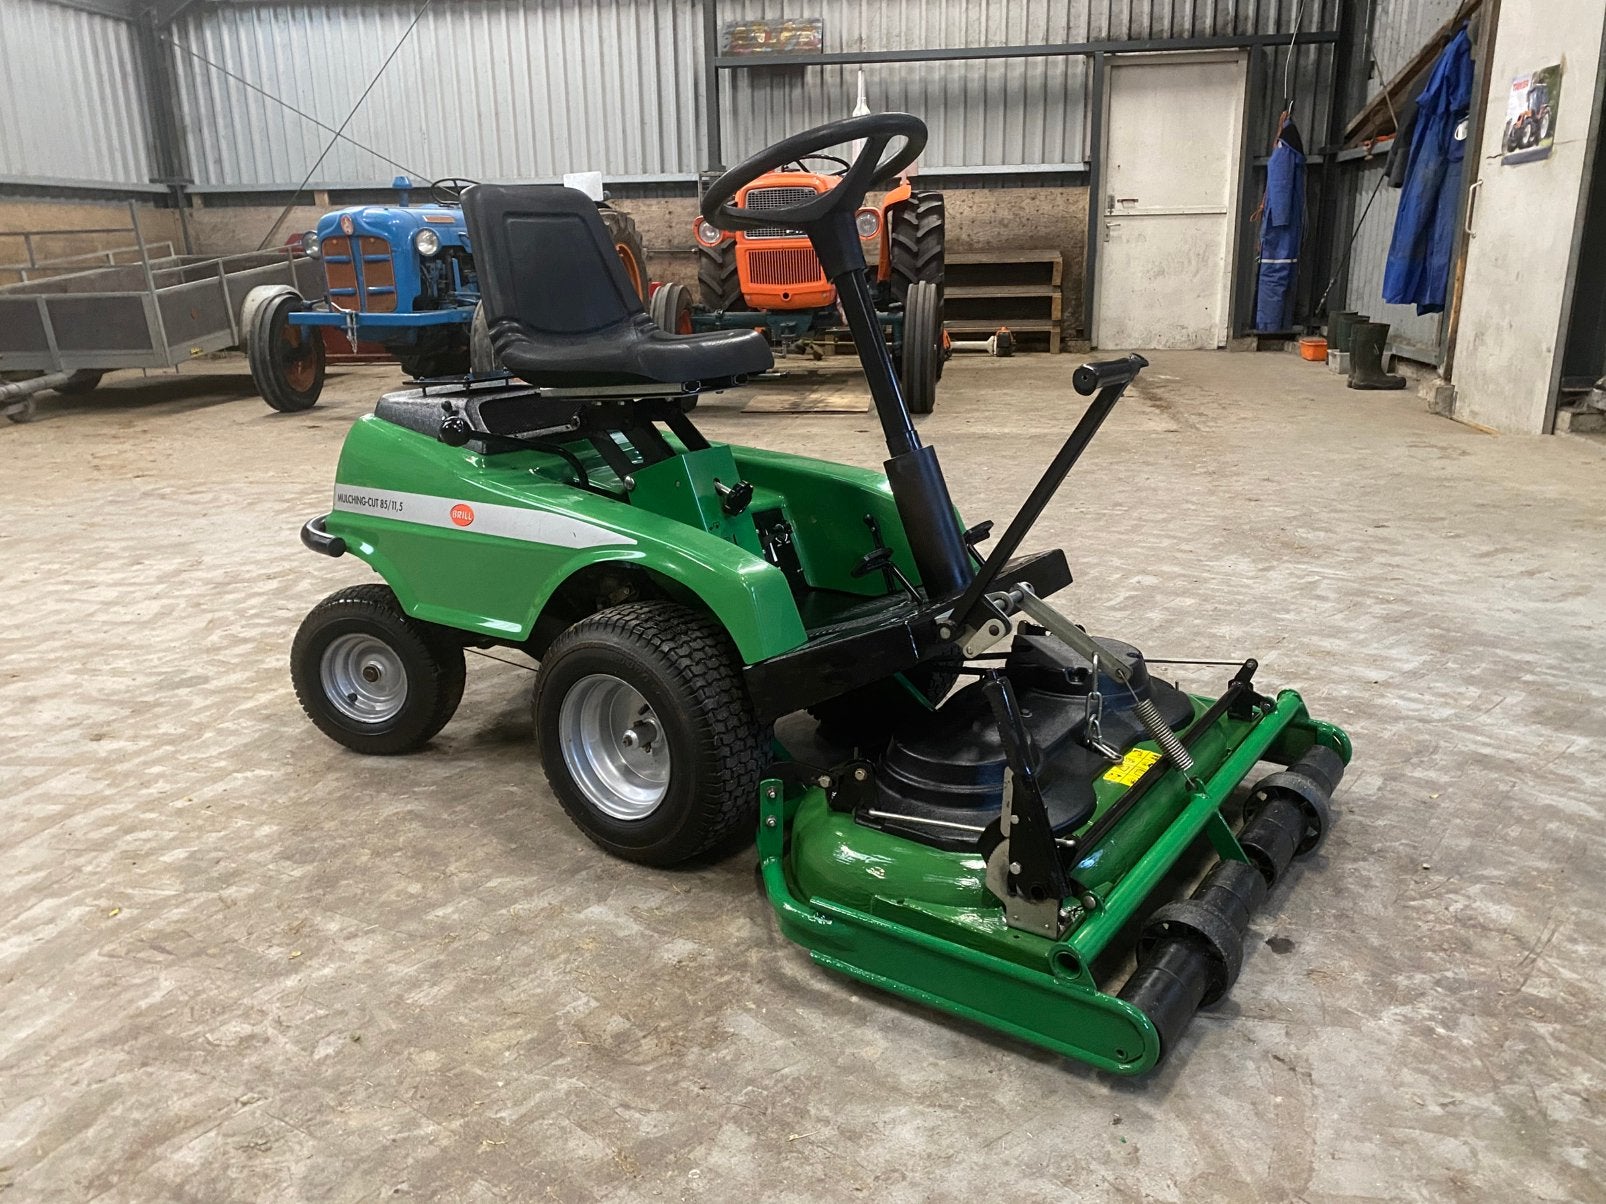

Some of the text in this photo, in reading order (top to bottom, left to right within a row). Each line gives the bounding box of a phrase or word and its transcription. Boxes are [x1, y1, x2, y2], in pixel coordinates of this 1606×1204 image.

[337, 493, 404, 512] MULCHING-CUT 85/11,5
[452, 509, 472, 521] BRILL
